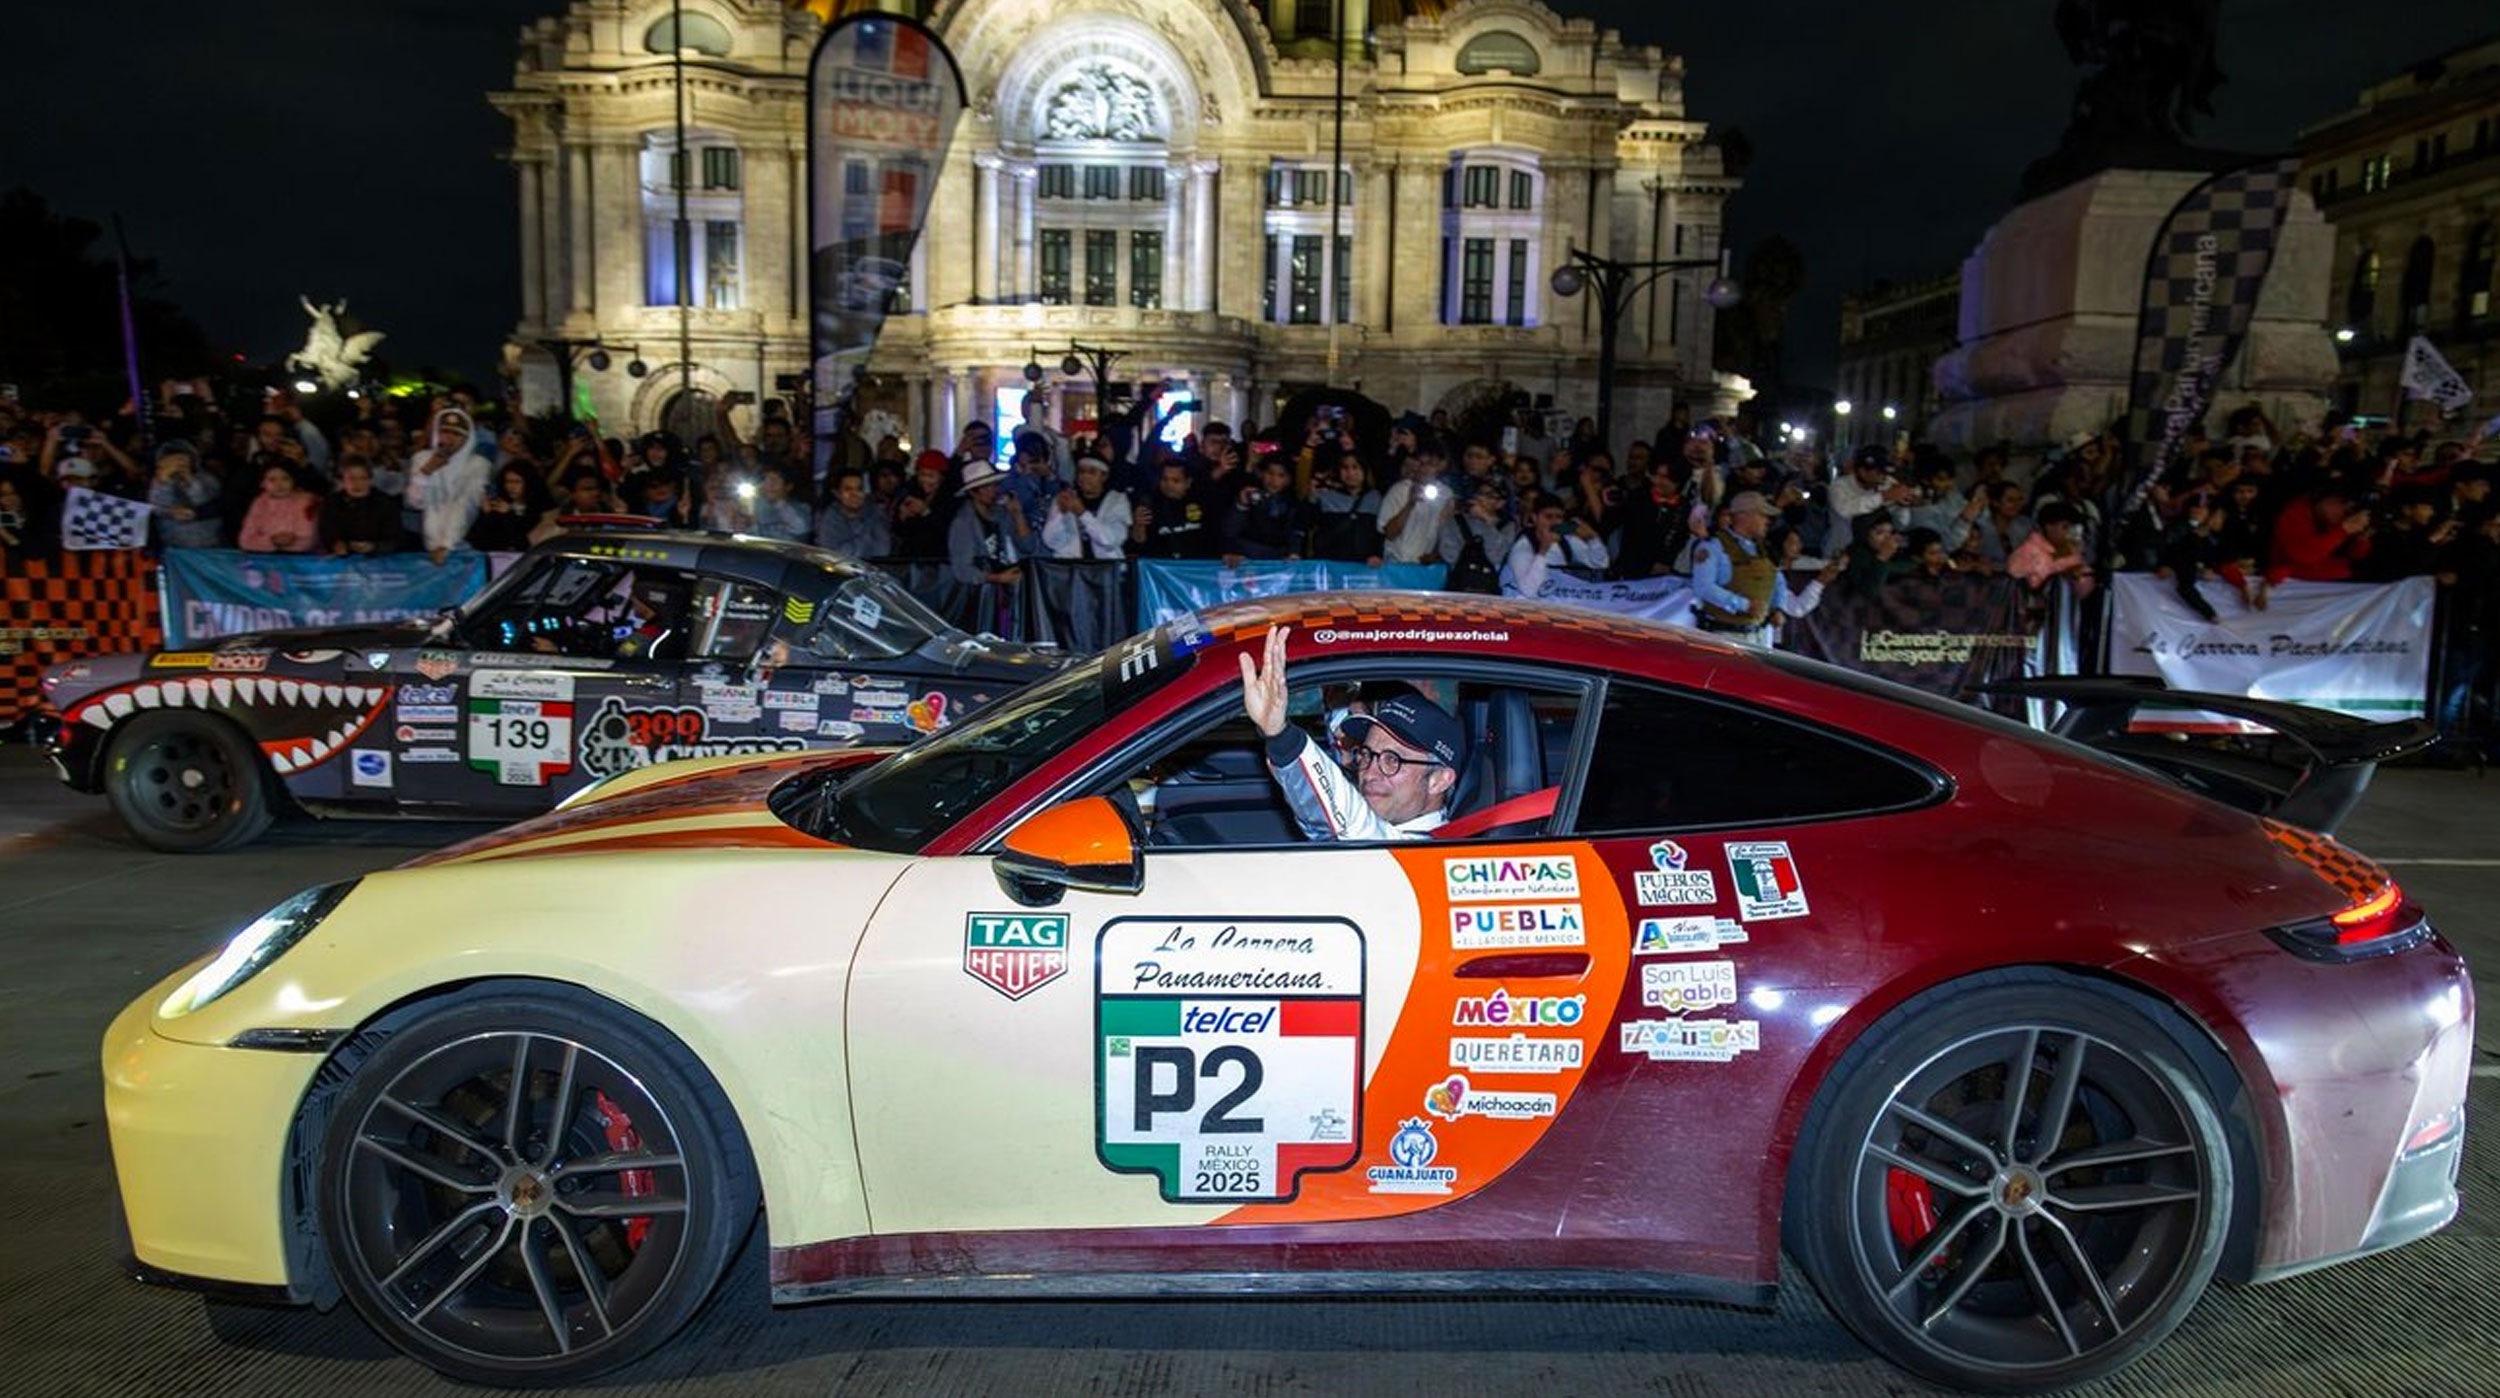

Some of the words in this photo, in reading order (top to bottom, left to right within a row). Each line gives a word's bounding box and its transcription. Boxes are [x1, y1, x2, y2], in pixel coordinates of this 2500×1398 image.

[487, 718, 550, 750] 139
[1449, 860, 1573, 883] CHIAPAS
[976, 919, 1058, 945] TAG
[1153, 925, 1195, 952] La
[1211, 925, 1315, 953] Carrera
[971, 951, 1060, 992] HEUER
[1645, 966, 1685, 984] San
[1690, 963, 1732, 982] Luis
[1183, 1006, 1276, 1034] telcel
[1624, 1021, 1757, 1050] ZACATECAS
[1455, 1038, 1580, 1063] QUERÉTARO
[1133, 1044, 1264, 1134] P2
[1467, 1096, 1552, 1113] Michoacán
[1205, 1145, 1253, 1157] RALLY
[1195, 1172, 1260, 1192] 2025
[1368, 1168, 1455, 1181] GUANAJUATO
